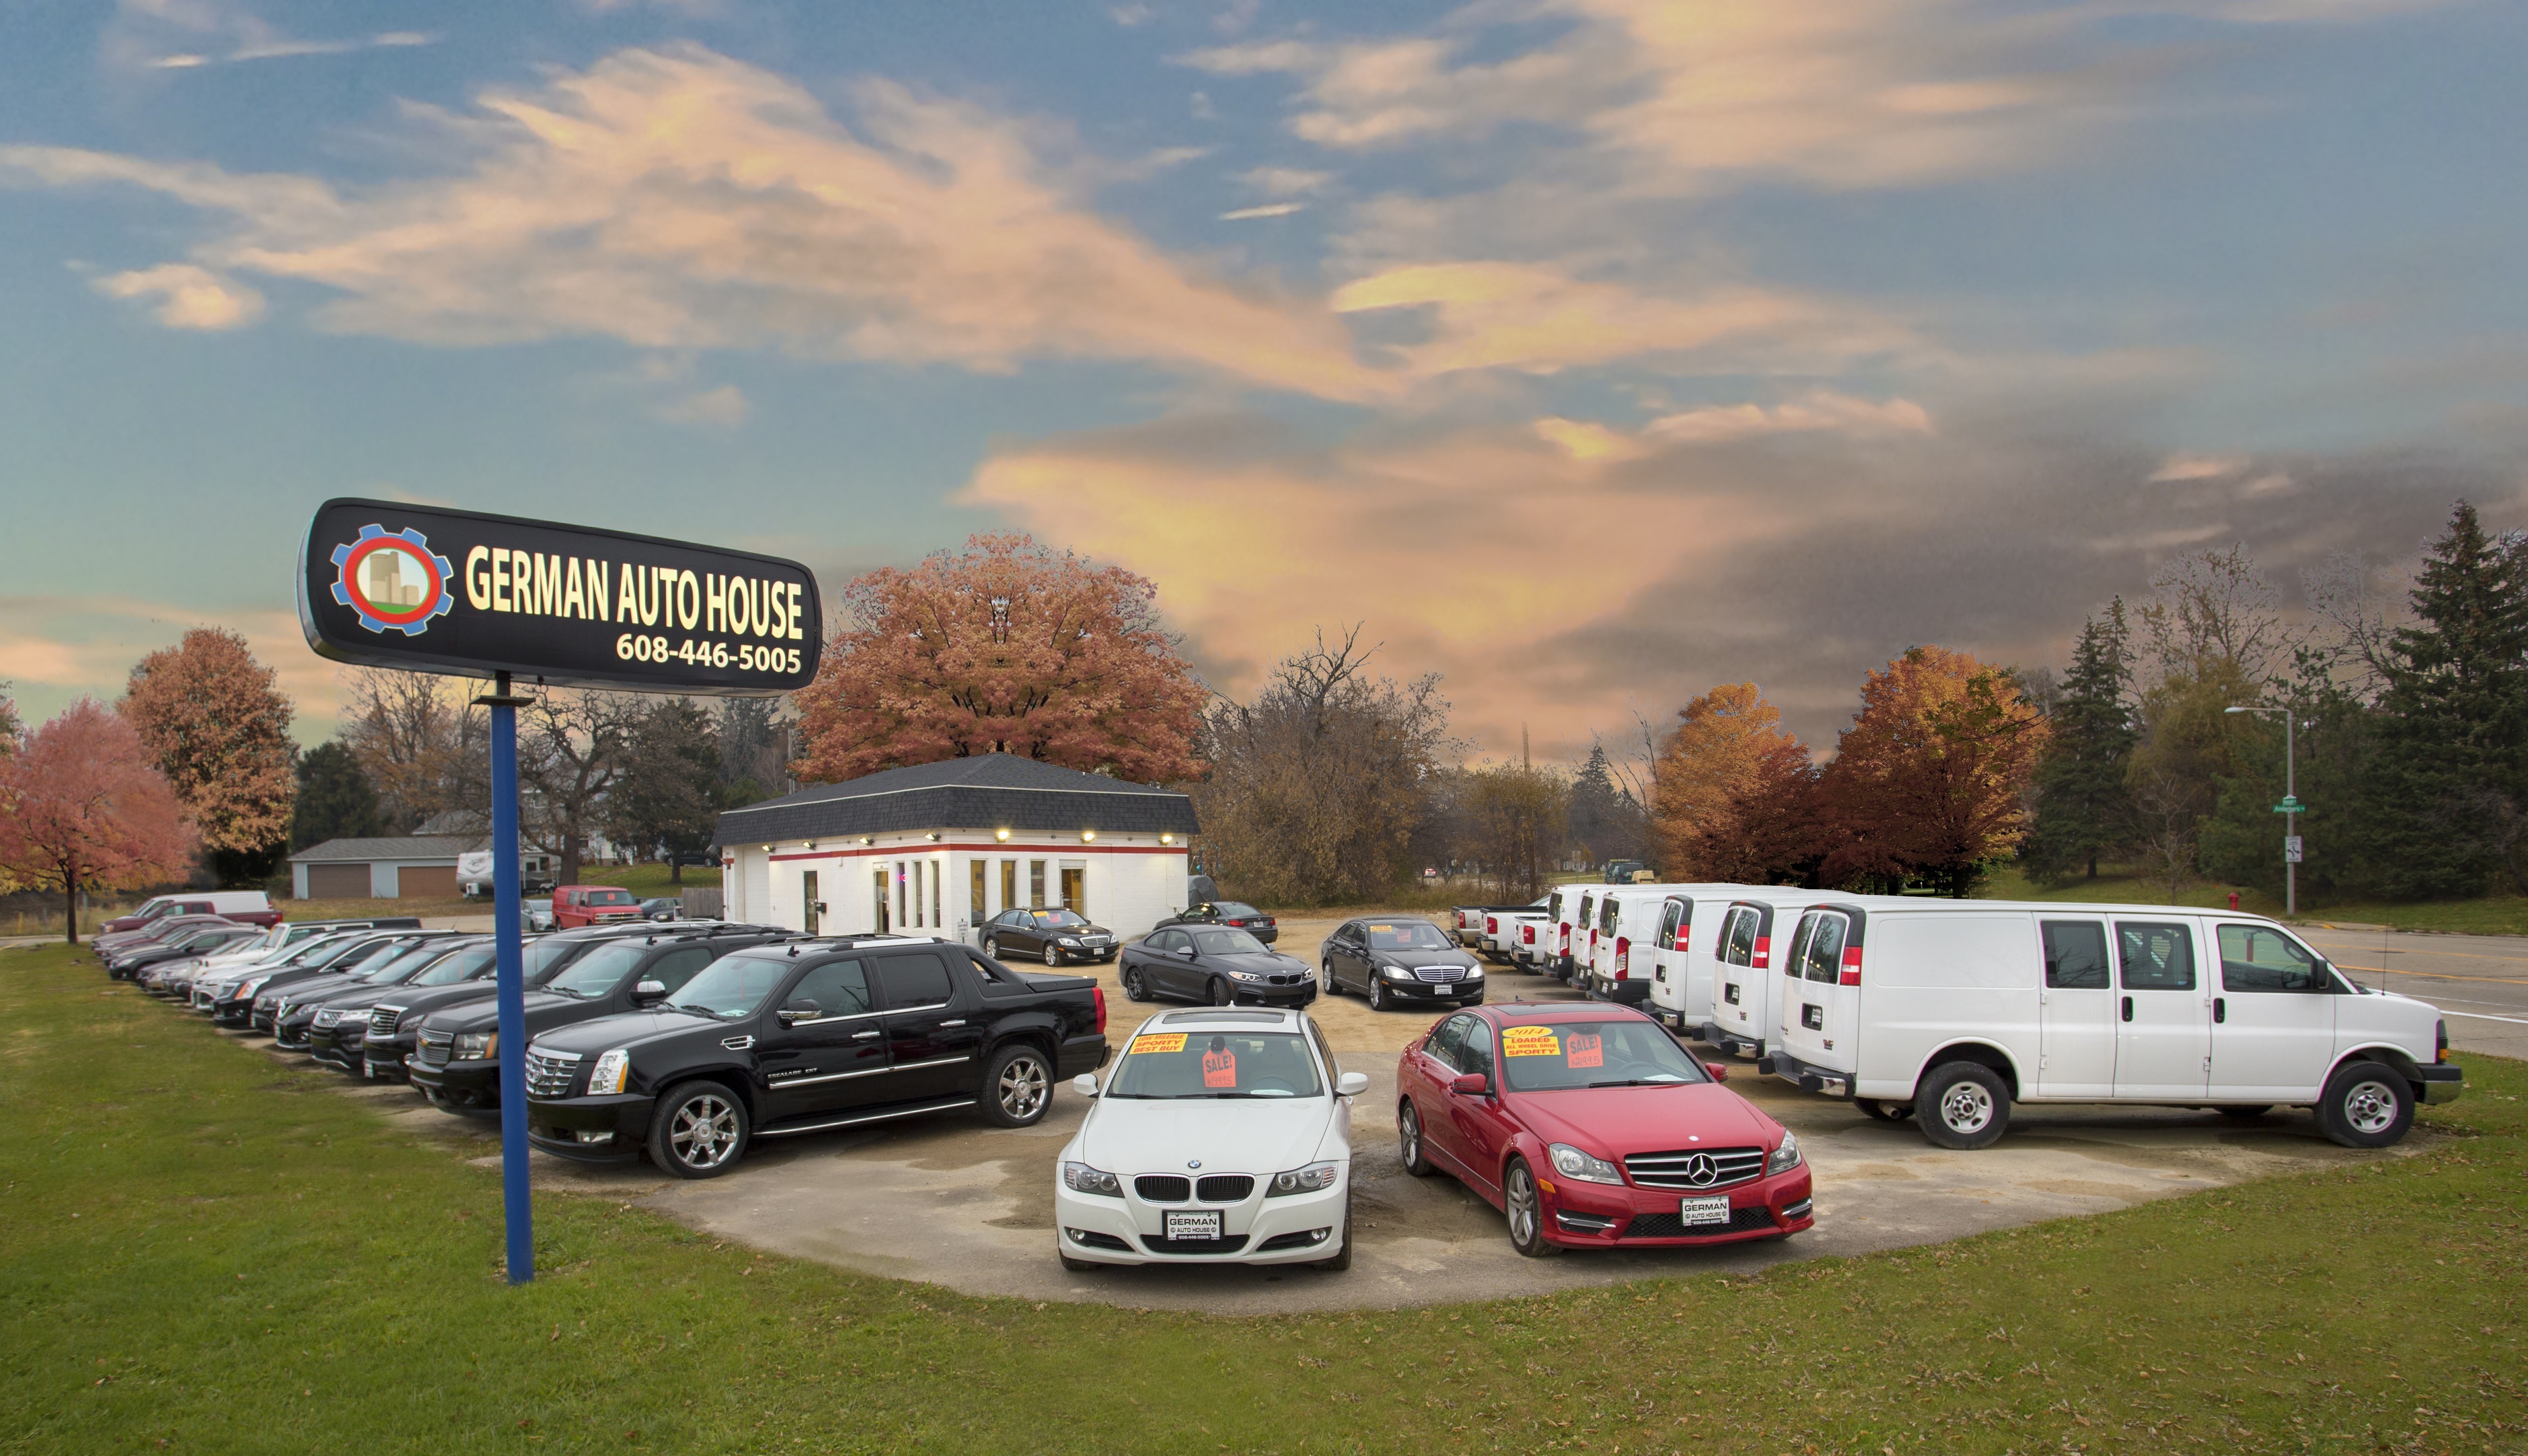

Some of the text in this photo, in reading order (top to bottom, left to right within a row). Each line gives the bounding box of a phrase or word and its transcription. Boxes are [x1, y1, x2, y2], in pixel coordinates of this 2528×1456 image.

[466, 545, 803, 640] GERMAN AUTO HOUSE
[617, 633, 802, 674] 608-446-5005
[1570, 1035, 1598, 1054] SALE!
[1206, 1055, 1232, 1073] SALE!
[768, 1070, 801, 1078] ESCALADE
[1685, 1203, 1727, 1211] GERMAN
